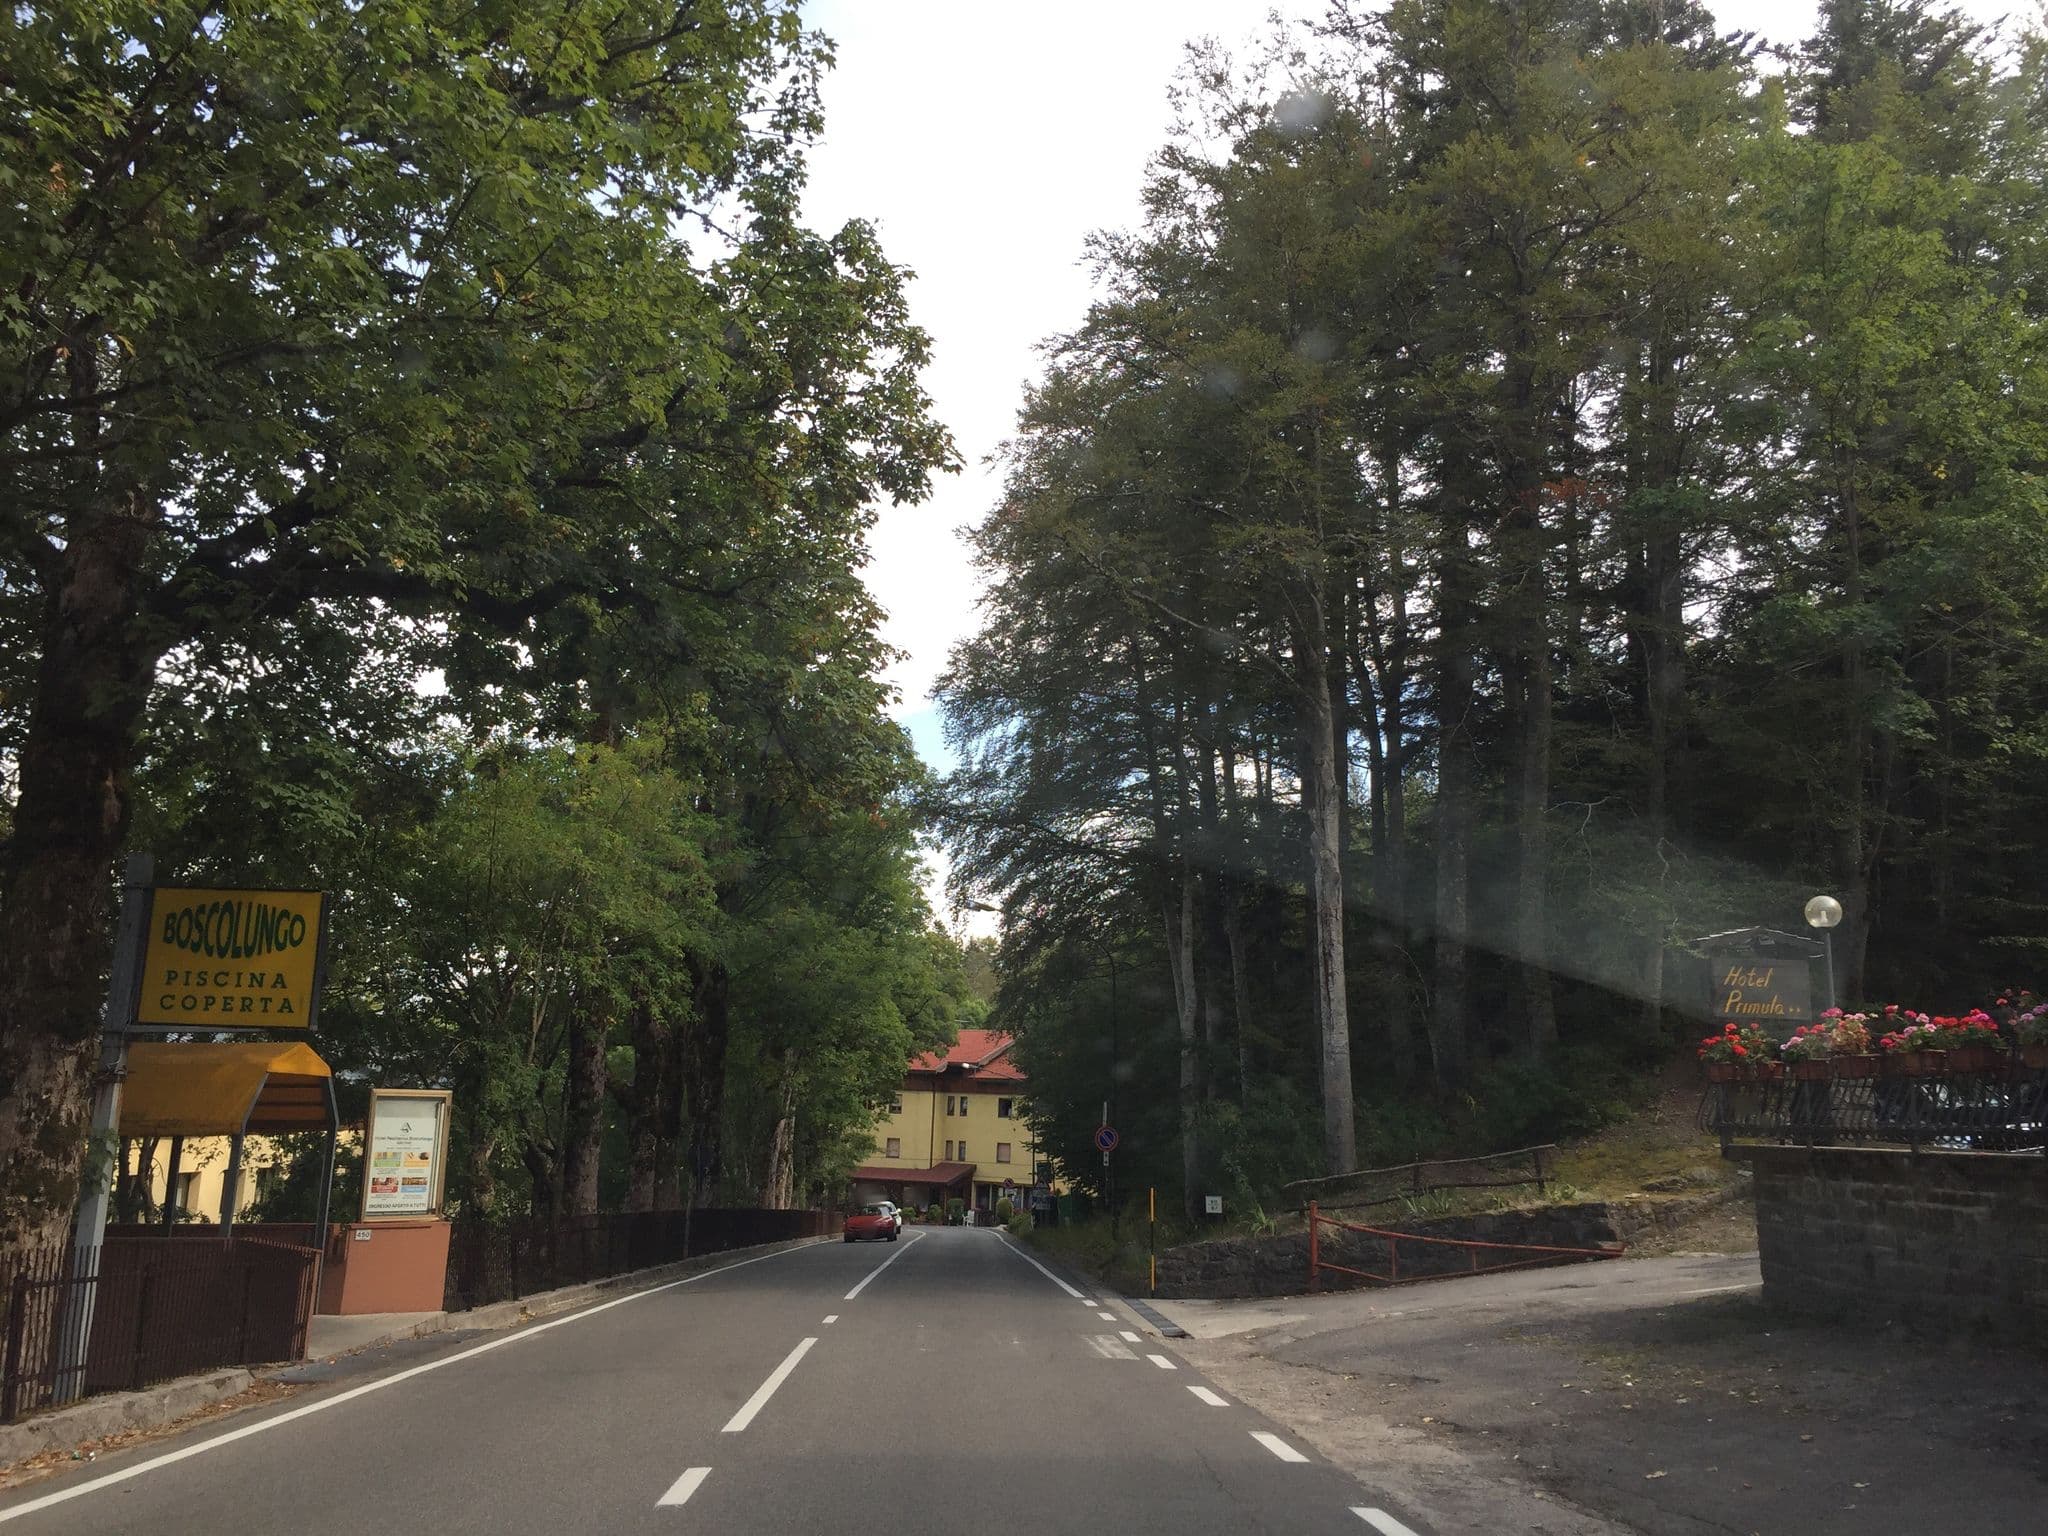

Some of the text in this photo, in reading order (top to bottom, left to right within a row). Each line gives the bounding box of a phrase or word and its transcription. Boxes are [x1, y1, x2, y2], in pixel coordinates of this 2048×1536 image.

[163, 899, 306, 959] BOSCOLUNGO
[164, 969, 288, 989] PISCINA
[1723, 966, 1774, 988] Hotel
[159, 995, 295, 1014] COPERTA
[1723, 989, 1784, 1015] Primula
